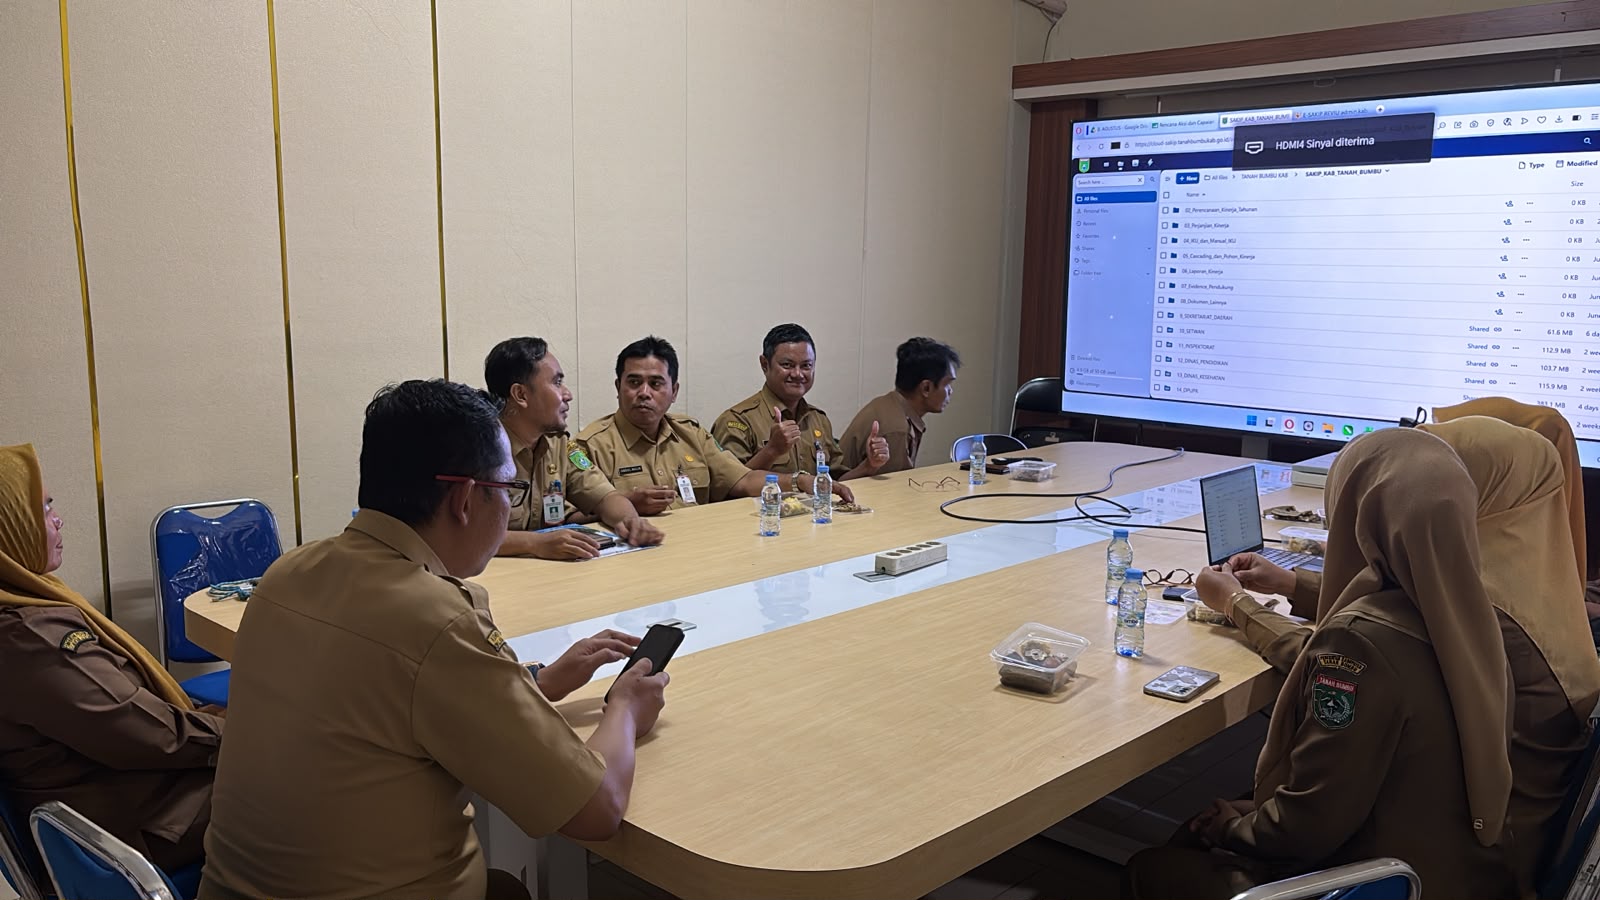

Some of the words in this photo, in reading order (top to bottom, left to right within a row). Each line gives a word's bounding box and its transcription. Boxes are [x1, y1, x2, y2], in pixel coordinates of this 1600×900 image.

[1276, 138, 1304, 150] HDMI4
[1306, 138, 1334, 150] Sinyal
[1336, 136, 1375, 148] diterima
[1305, 168, 1382, 177] SAKIP_KAB_TANAH_BUMBU
